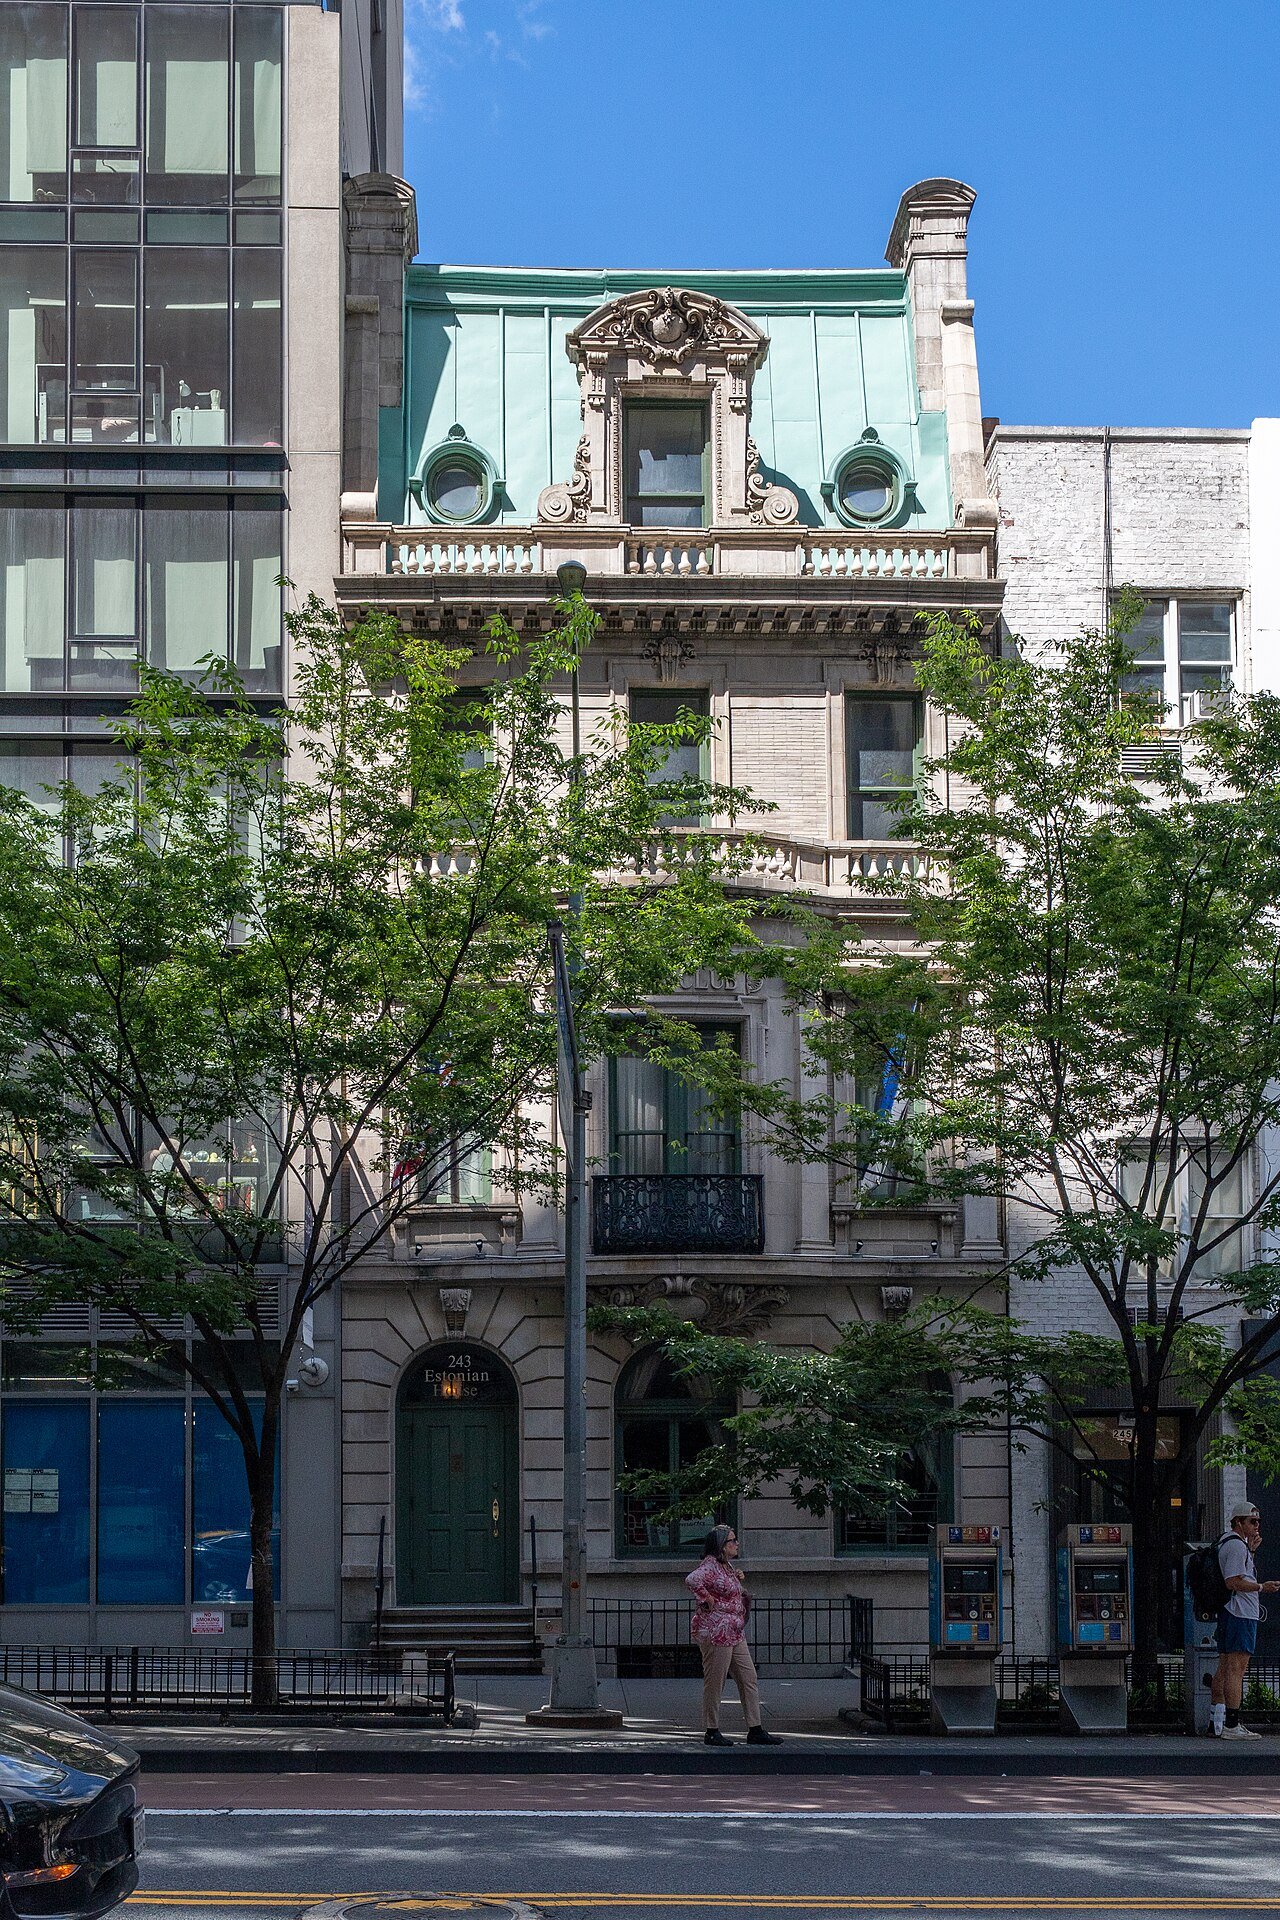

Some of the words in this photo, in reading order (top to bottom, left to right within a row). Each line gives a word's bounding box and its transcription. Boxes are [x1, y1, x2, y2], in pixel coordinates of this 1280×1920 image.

[448, 1355, 471, 1368] 243
[424, 1369, 489, 1382] Estonian
[1113, 1429, 1131, 1437] 245
